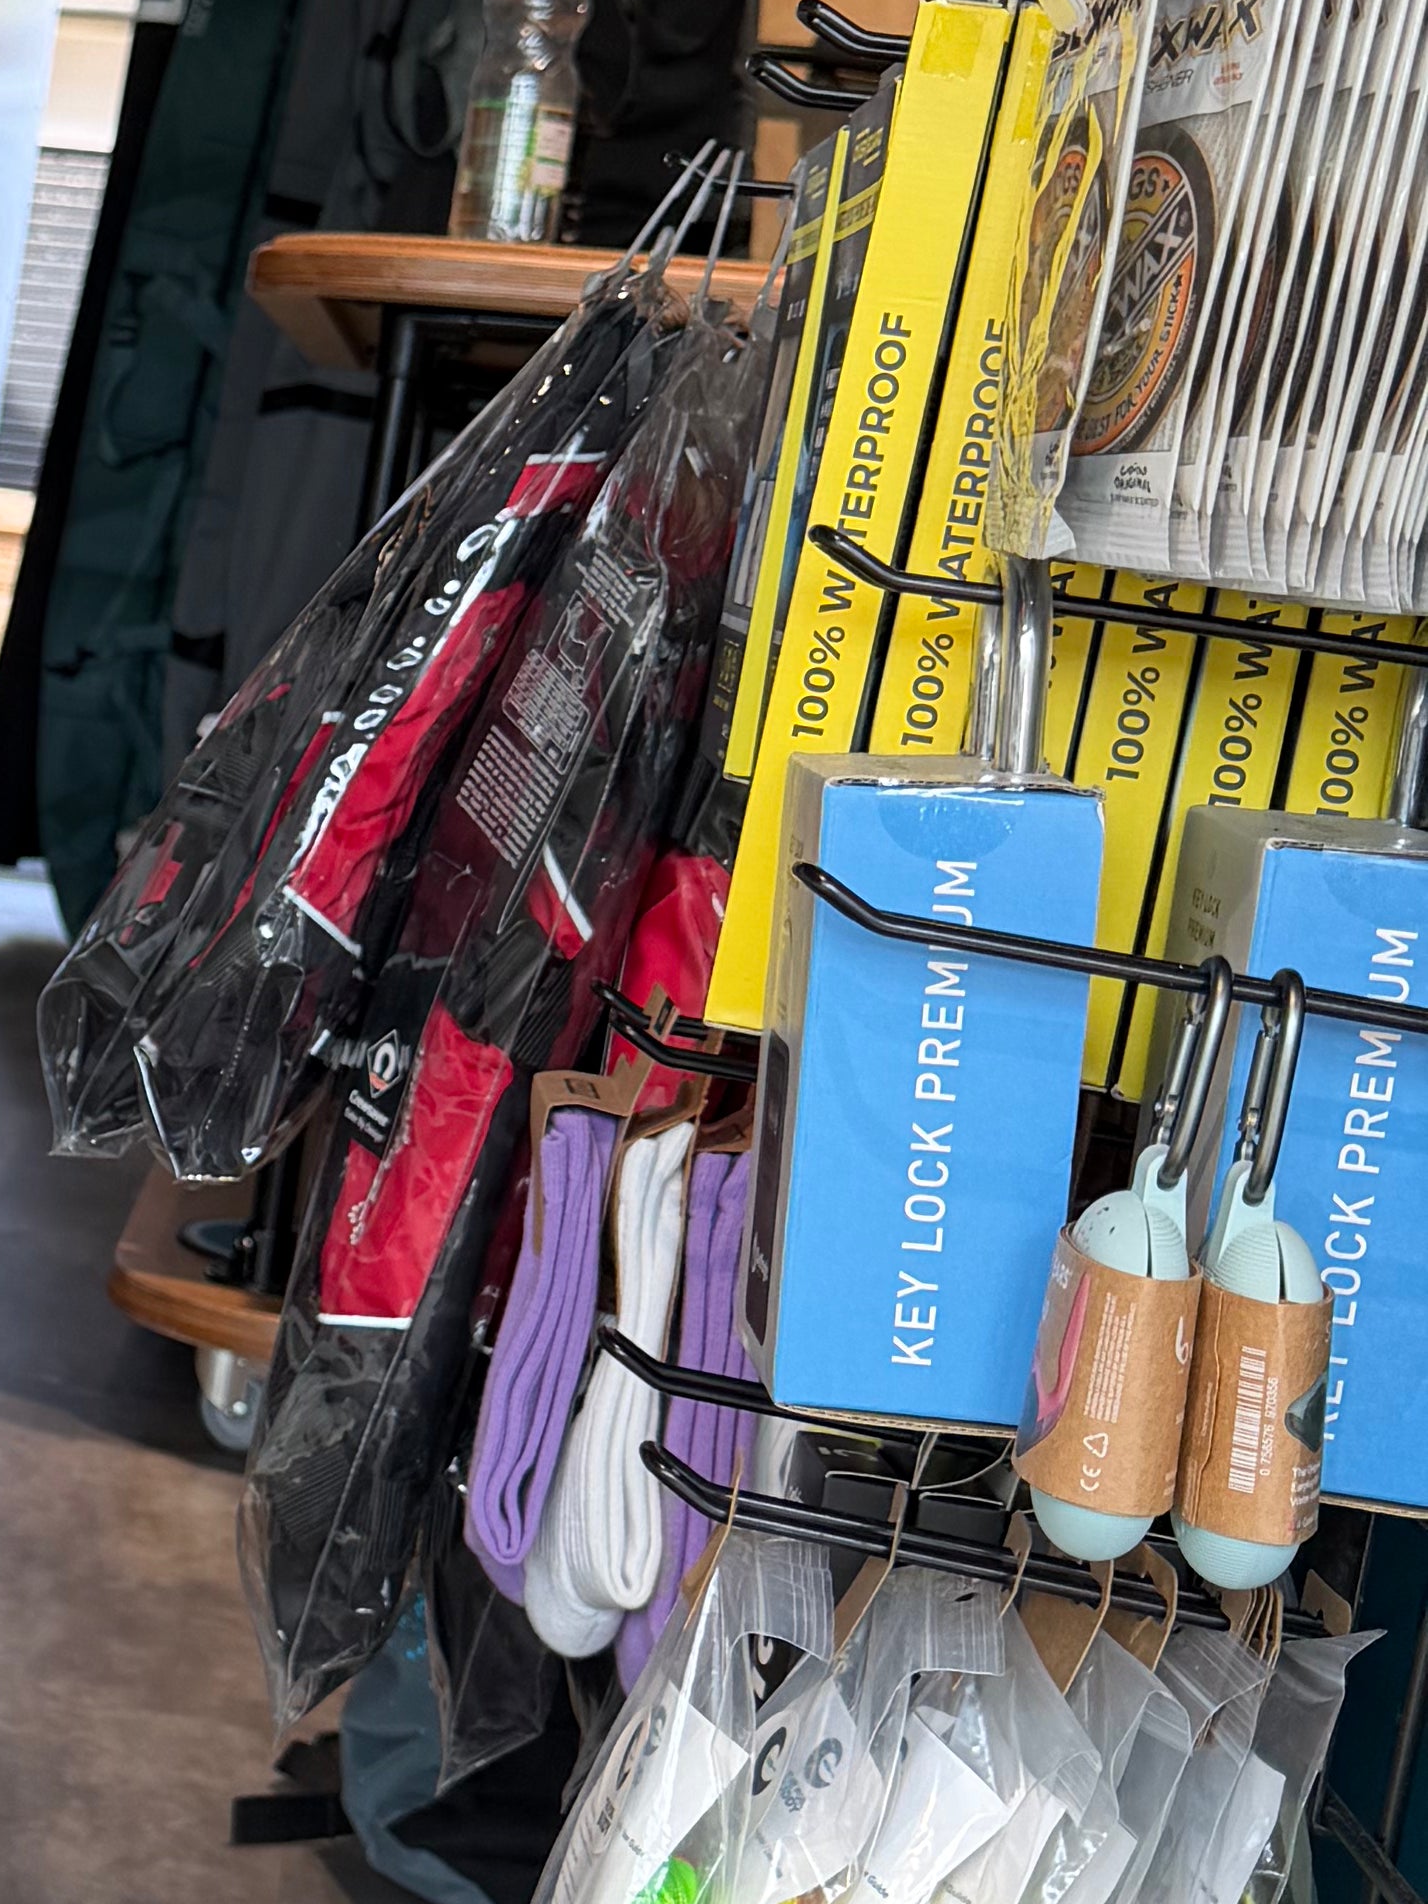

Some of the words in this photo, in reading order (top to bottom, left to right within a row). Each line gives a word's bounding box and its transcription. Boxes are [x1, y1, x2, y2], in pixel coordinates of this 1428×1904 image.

[1135, 347, 1164, 396] YOUR
[791, 626, 845, 738] 100%
[818, 311, 912, 614] WTERPROOF
[900, 632, 954, 747] 100%
[1106, 665, 1161, 782] 100%
[1208, 693, 1262, 807] 100%
[1316, 705, 1370, 817] 100%
[1336, 927, 1419, 1175] PREMUM
[900, 1122, 954, 1253] LOCK
[890, 1270, 940, 1367] KEY
